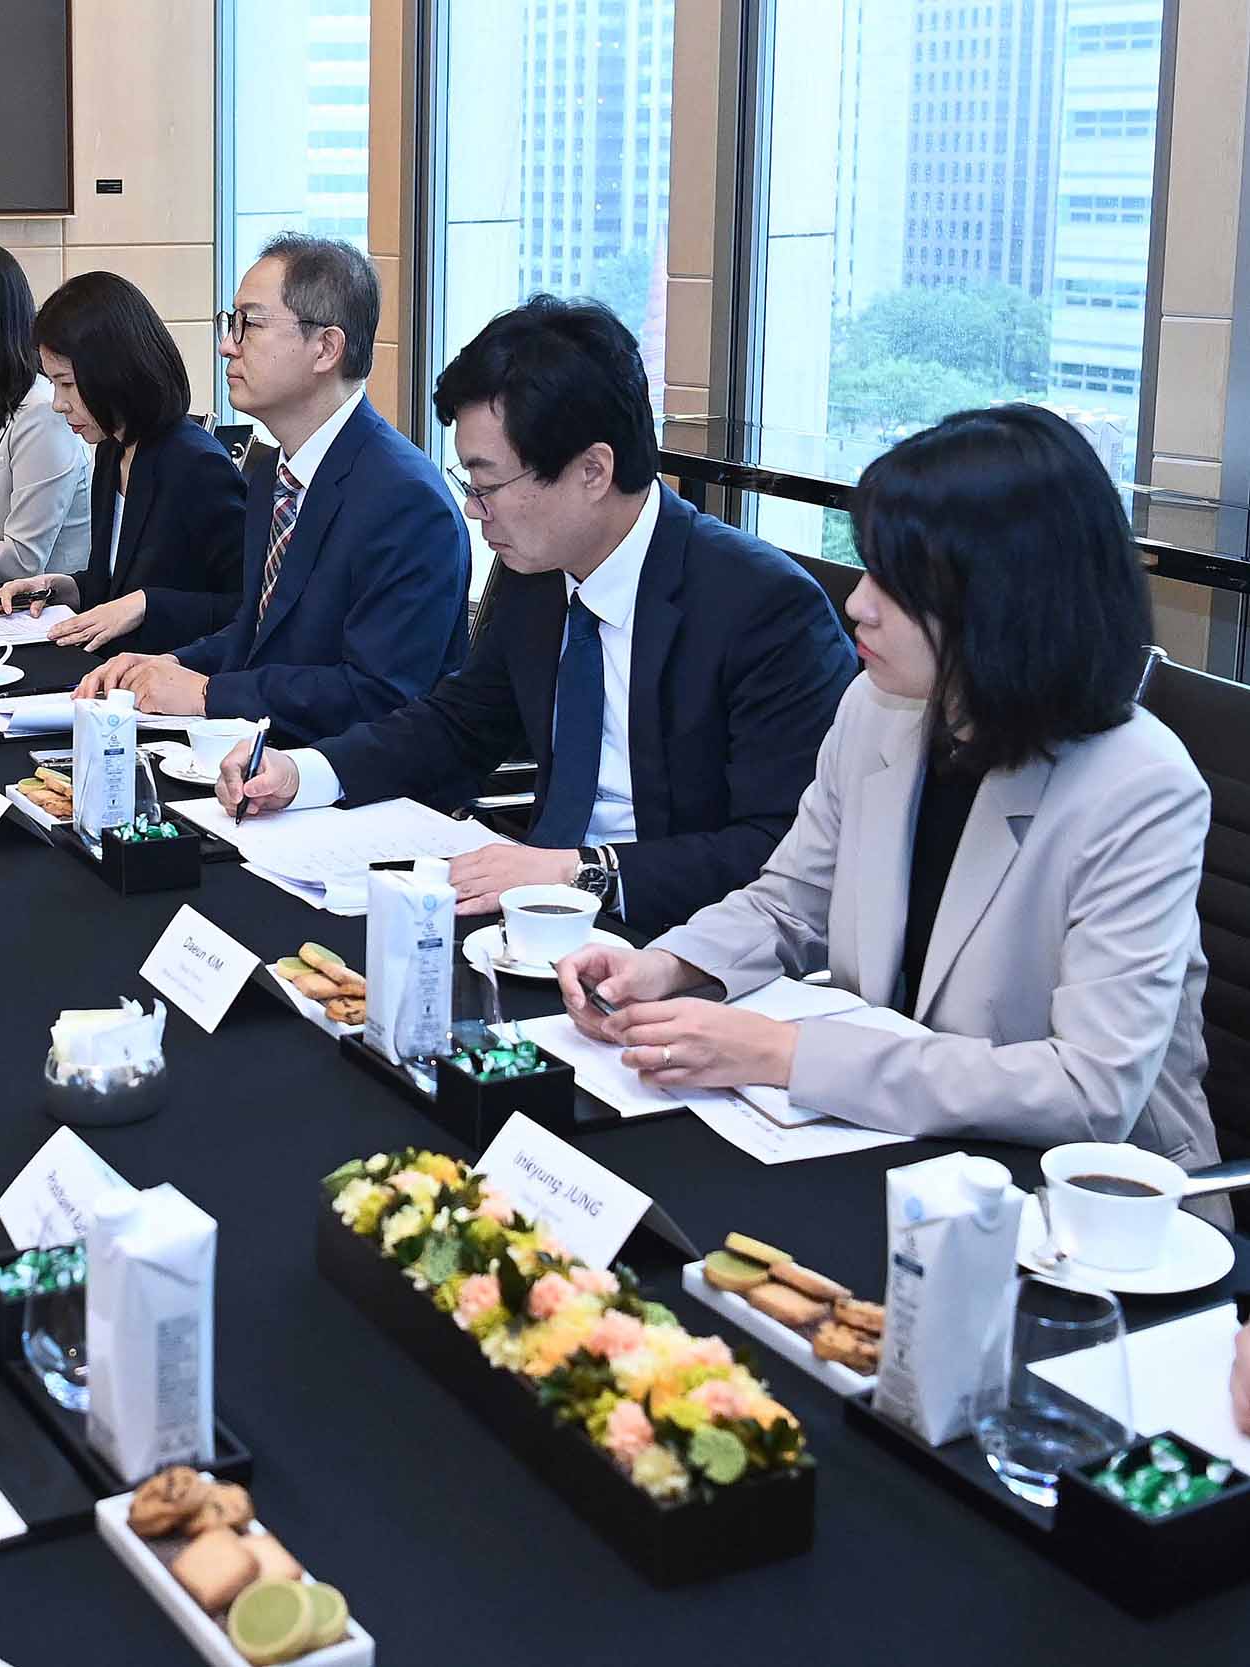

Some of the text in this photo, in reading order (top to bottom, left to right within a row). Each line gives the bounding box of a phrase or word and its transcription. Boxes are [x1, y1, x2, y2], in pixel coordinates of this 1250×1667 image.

[206, 953, 225, 972] KIM
[514, 1150, 563, 1195] Inkyung
[563, 1185, 603, 1217] JUNG
